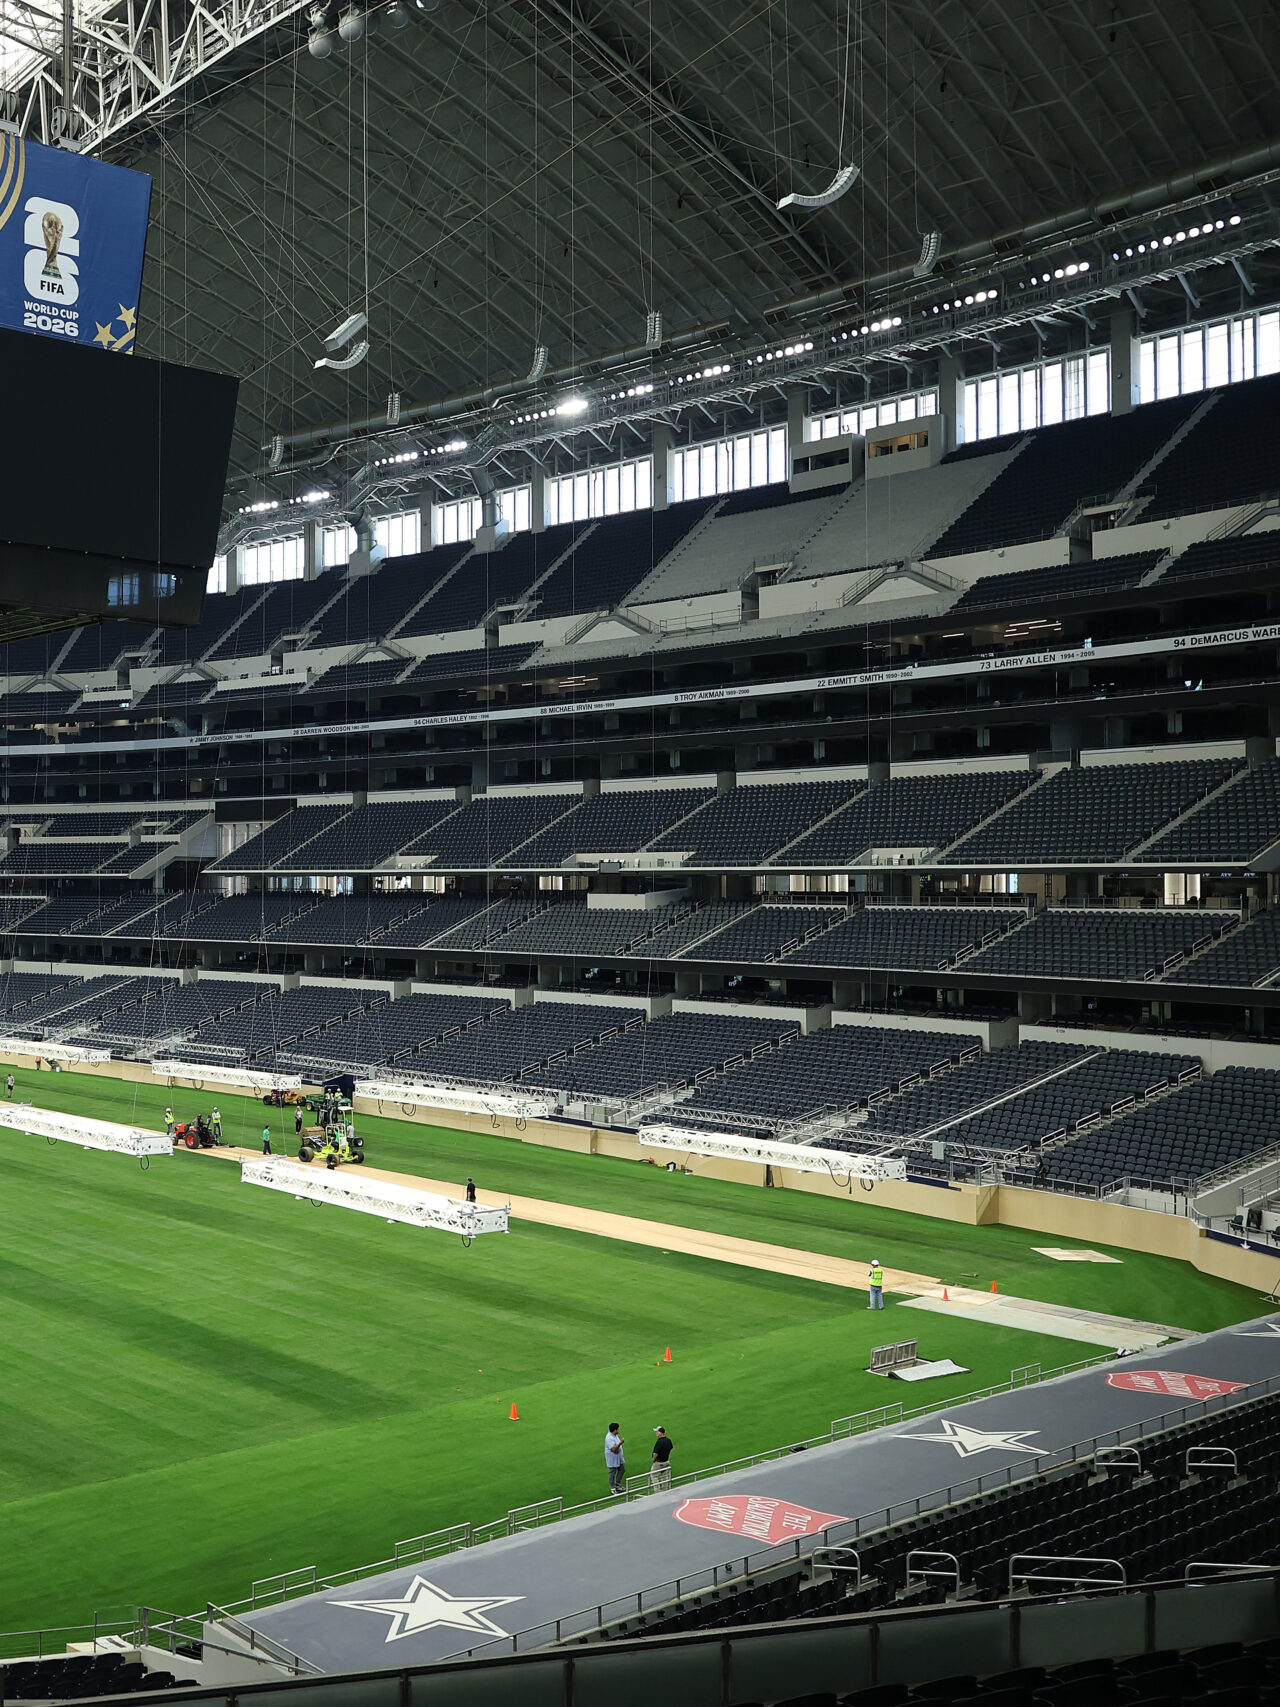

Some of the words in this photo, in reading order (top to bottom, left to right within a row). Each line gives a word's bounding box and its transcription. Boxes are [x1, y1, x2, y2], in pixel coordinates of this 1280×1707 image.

[40, 280, 65, 295] FIFA
[24, 300, 59, 318] WORLD
[60, 309, 79, 321] CUP
[23, 312, 79, 337] 2026
[1173, 638, 1186, 648] 94
[980, 662, 991, 670] 73
[994, 658, 1023, 668] LARRY
[1025, 654, 1056, 665] ALLEN
[827, 676, 858, 686] EMMITT
[859, 673, 884, 683] SMITH
[680, 693, 698, 701] TROY
[698, 690, 724, 700] AIKMAN
[548, 705, 575, 714] MICHAEL
[576, 703, 593, 712] IRVIN
[421, 716, 448, 725] CHARLES
[448, 715, 468, 723] HALEY
[300, 727, 322, 735] DARREN
[323, 725, 351, 733] WOODSON
[782, 1511, 812, 1532] THE
